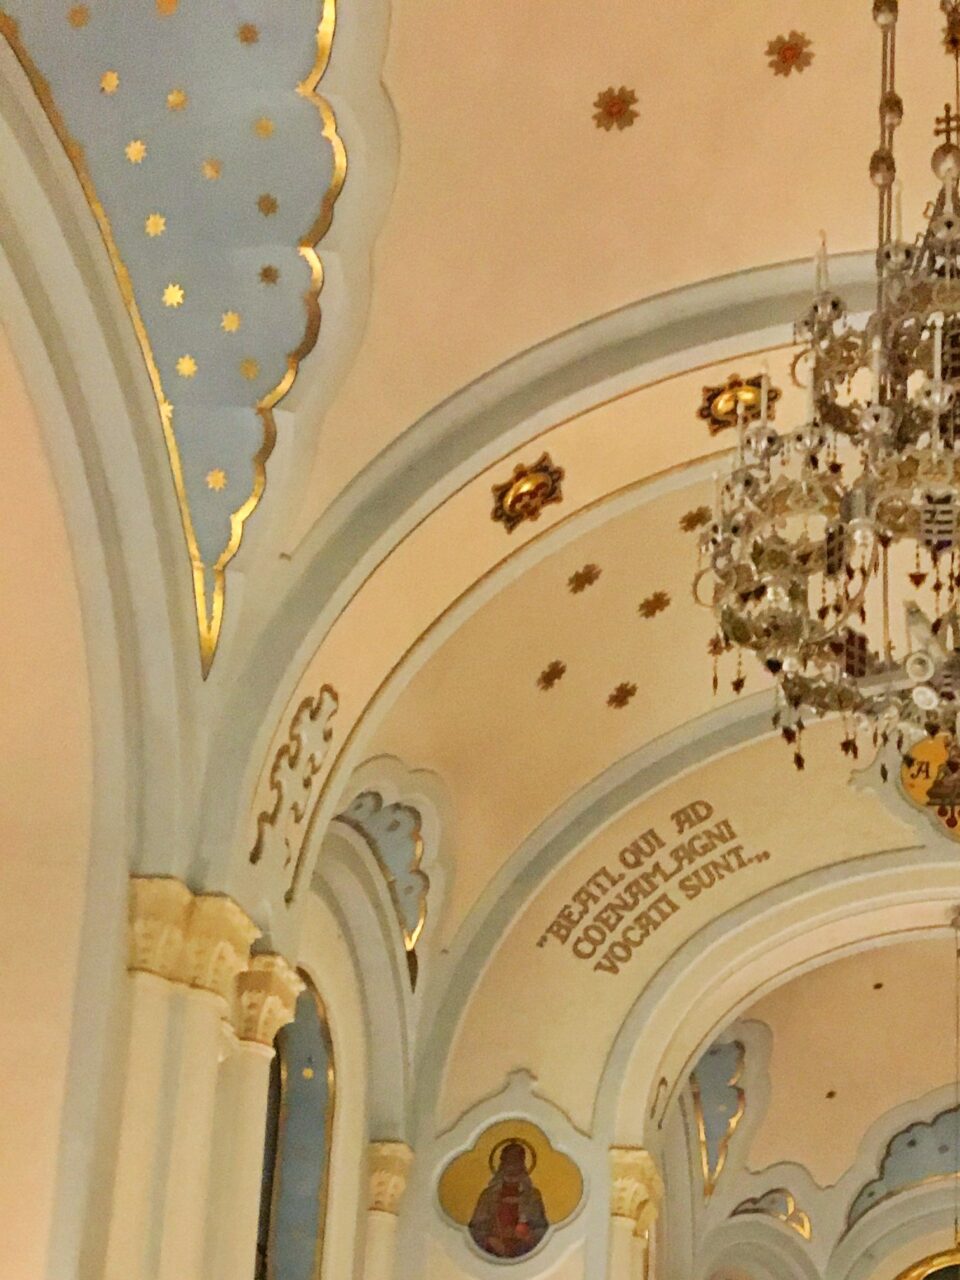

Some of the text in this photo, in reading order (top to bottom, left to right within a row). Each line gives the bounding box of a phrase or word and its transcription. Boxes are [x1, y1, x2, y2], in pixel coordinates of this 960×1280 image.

[619, 828, 666, 870] QUI
[670, 800, 714, 835] AD
[593, 893, 680, 976] VOCATI
